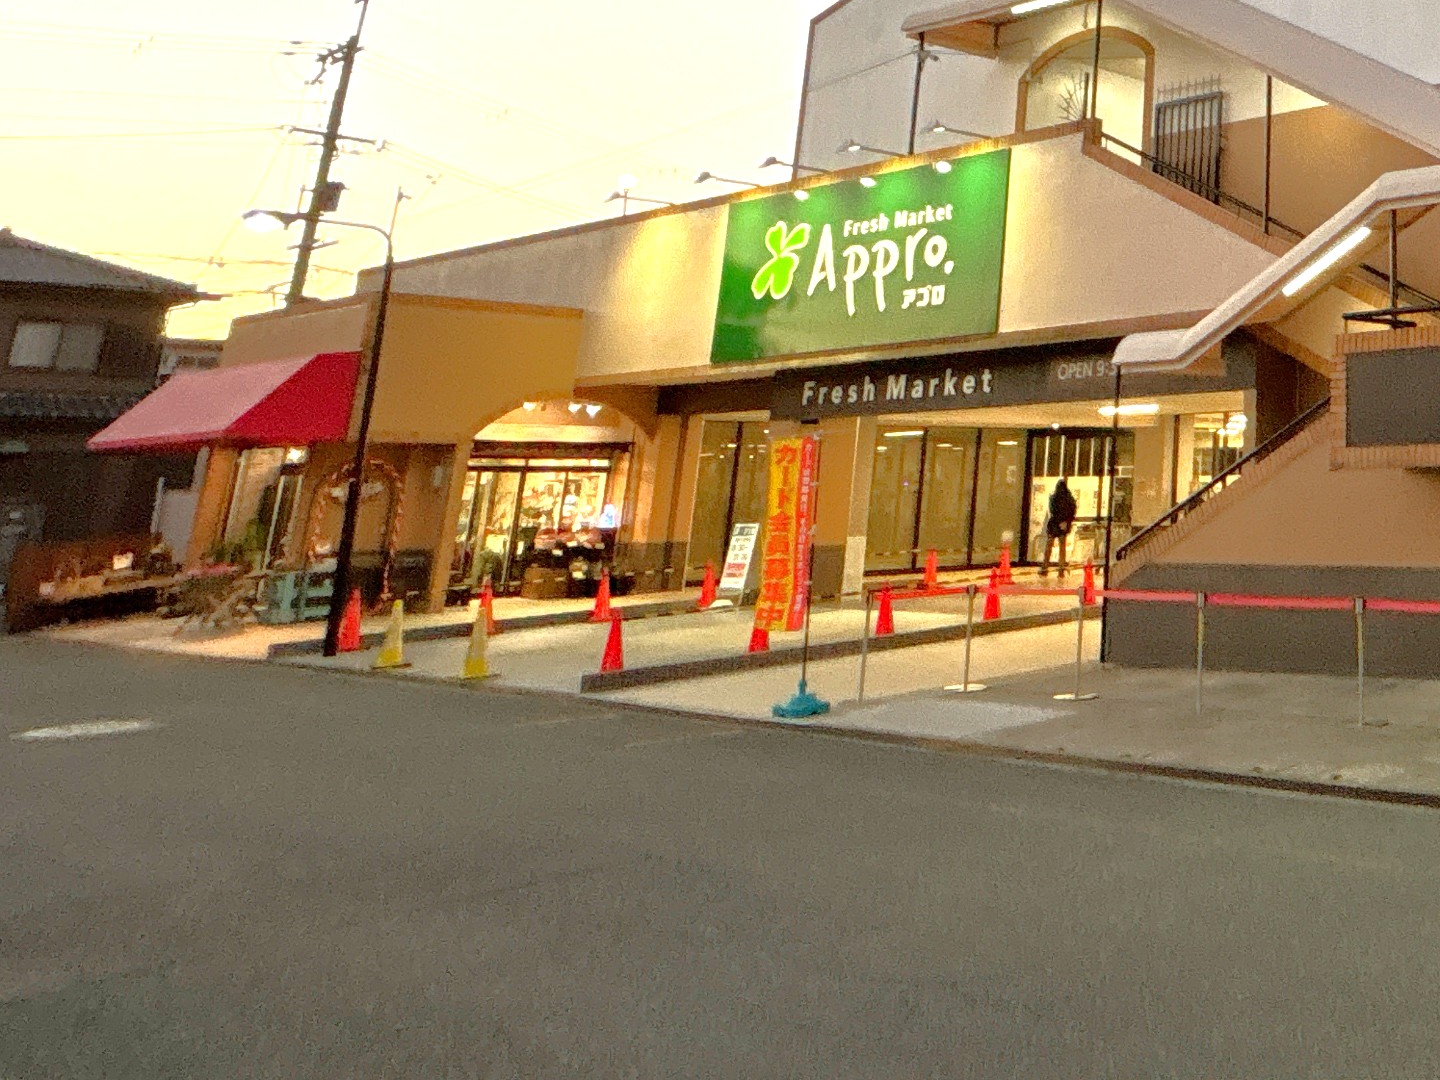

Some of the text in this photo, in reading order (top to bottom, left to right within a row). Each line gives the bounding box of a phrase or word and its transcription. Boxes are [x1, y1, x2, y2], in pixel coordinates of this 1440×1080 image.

[844, 204, 953, 237] Fresh Market
[901, 285, 945, 309] アプロ
[1057, 361, 1093, 380] OPEN
[802, 368, 992, 406] Fresh Market
